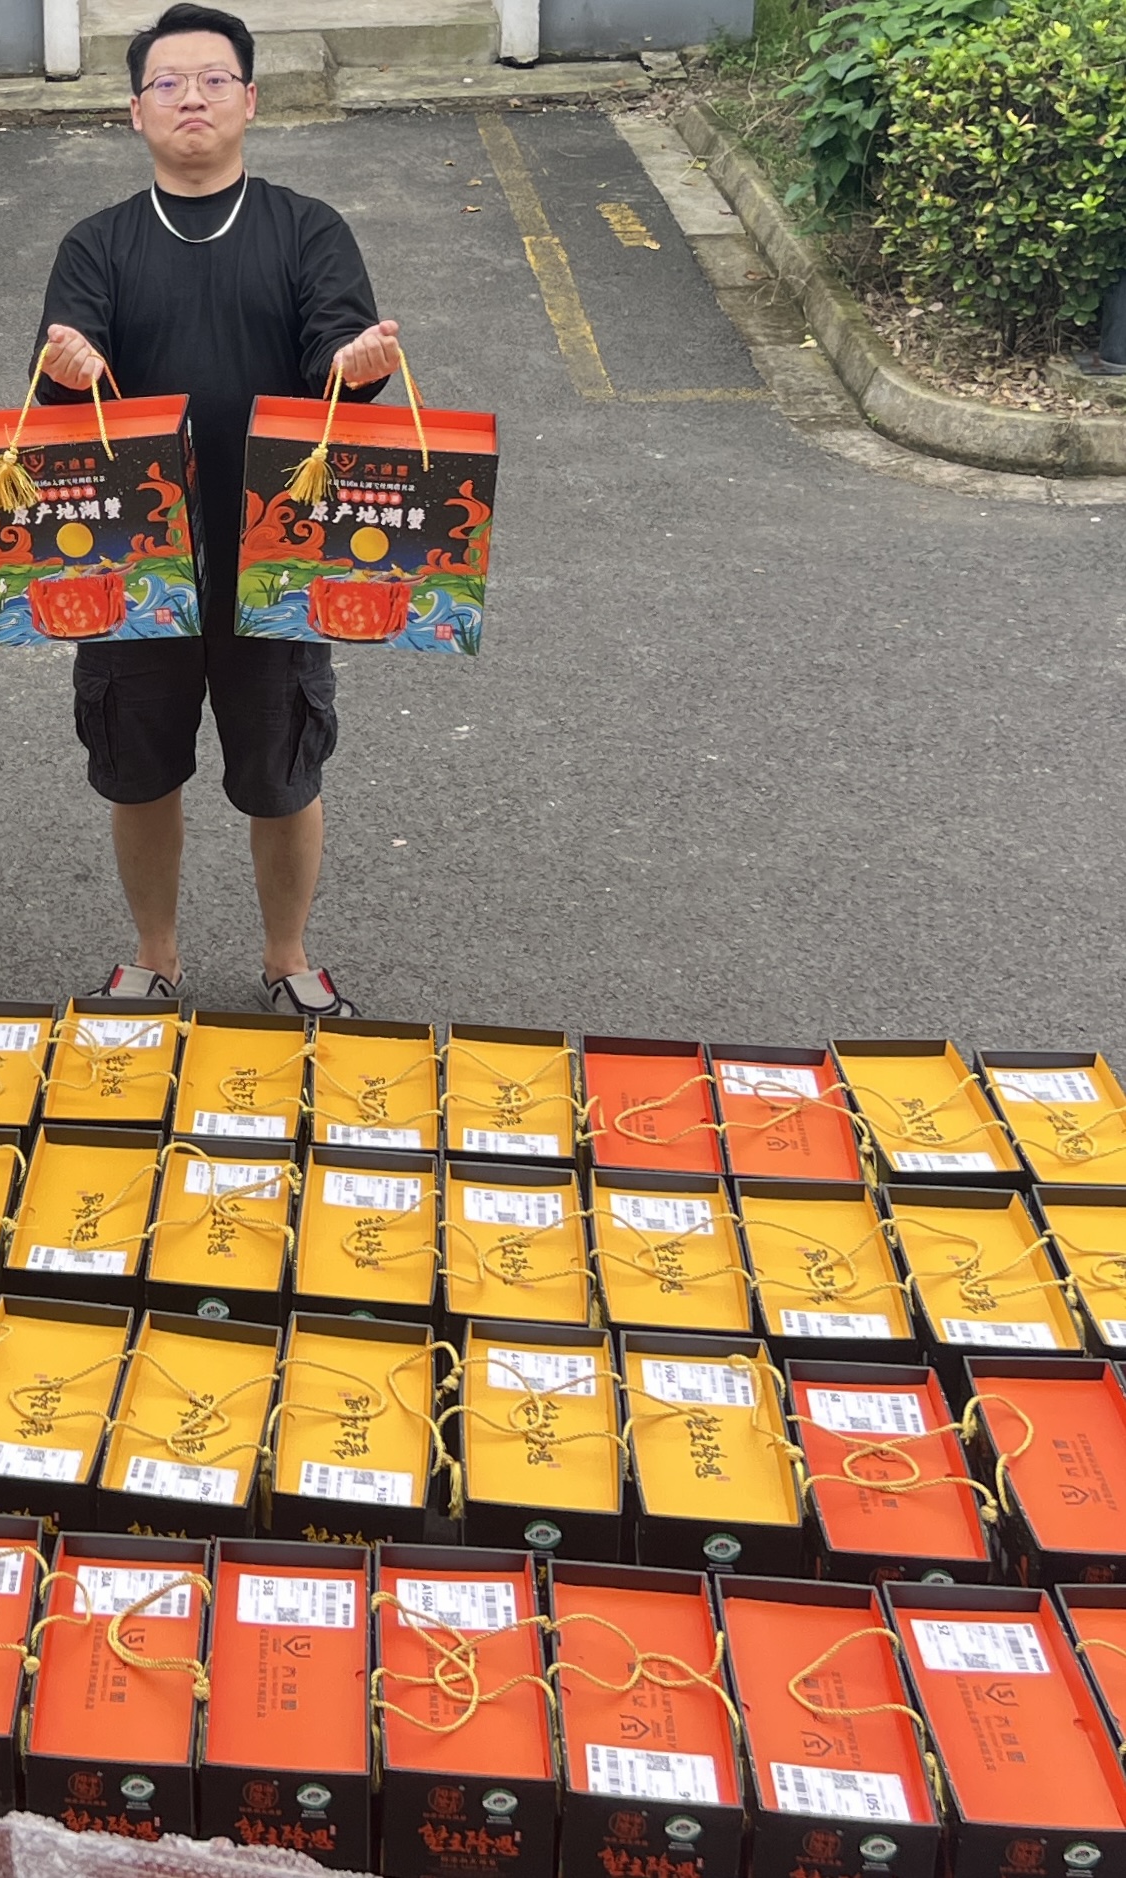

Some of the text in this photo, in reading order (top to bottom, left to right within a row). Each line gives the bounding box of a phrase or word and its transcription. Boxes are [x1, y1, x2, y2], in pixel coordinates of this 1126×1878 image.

[12, 496, 122, 525] 原产地湖蟹
[308, 501, 426, 530] 原产地湖蟹
[937, 1623, 949, 1637] S2
[418, 1821, 520, 1856] 蟹主隆恩
